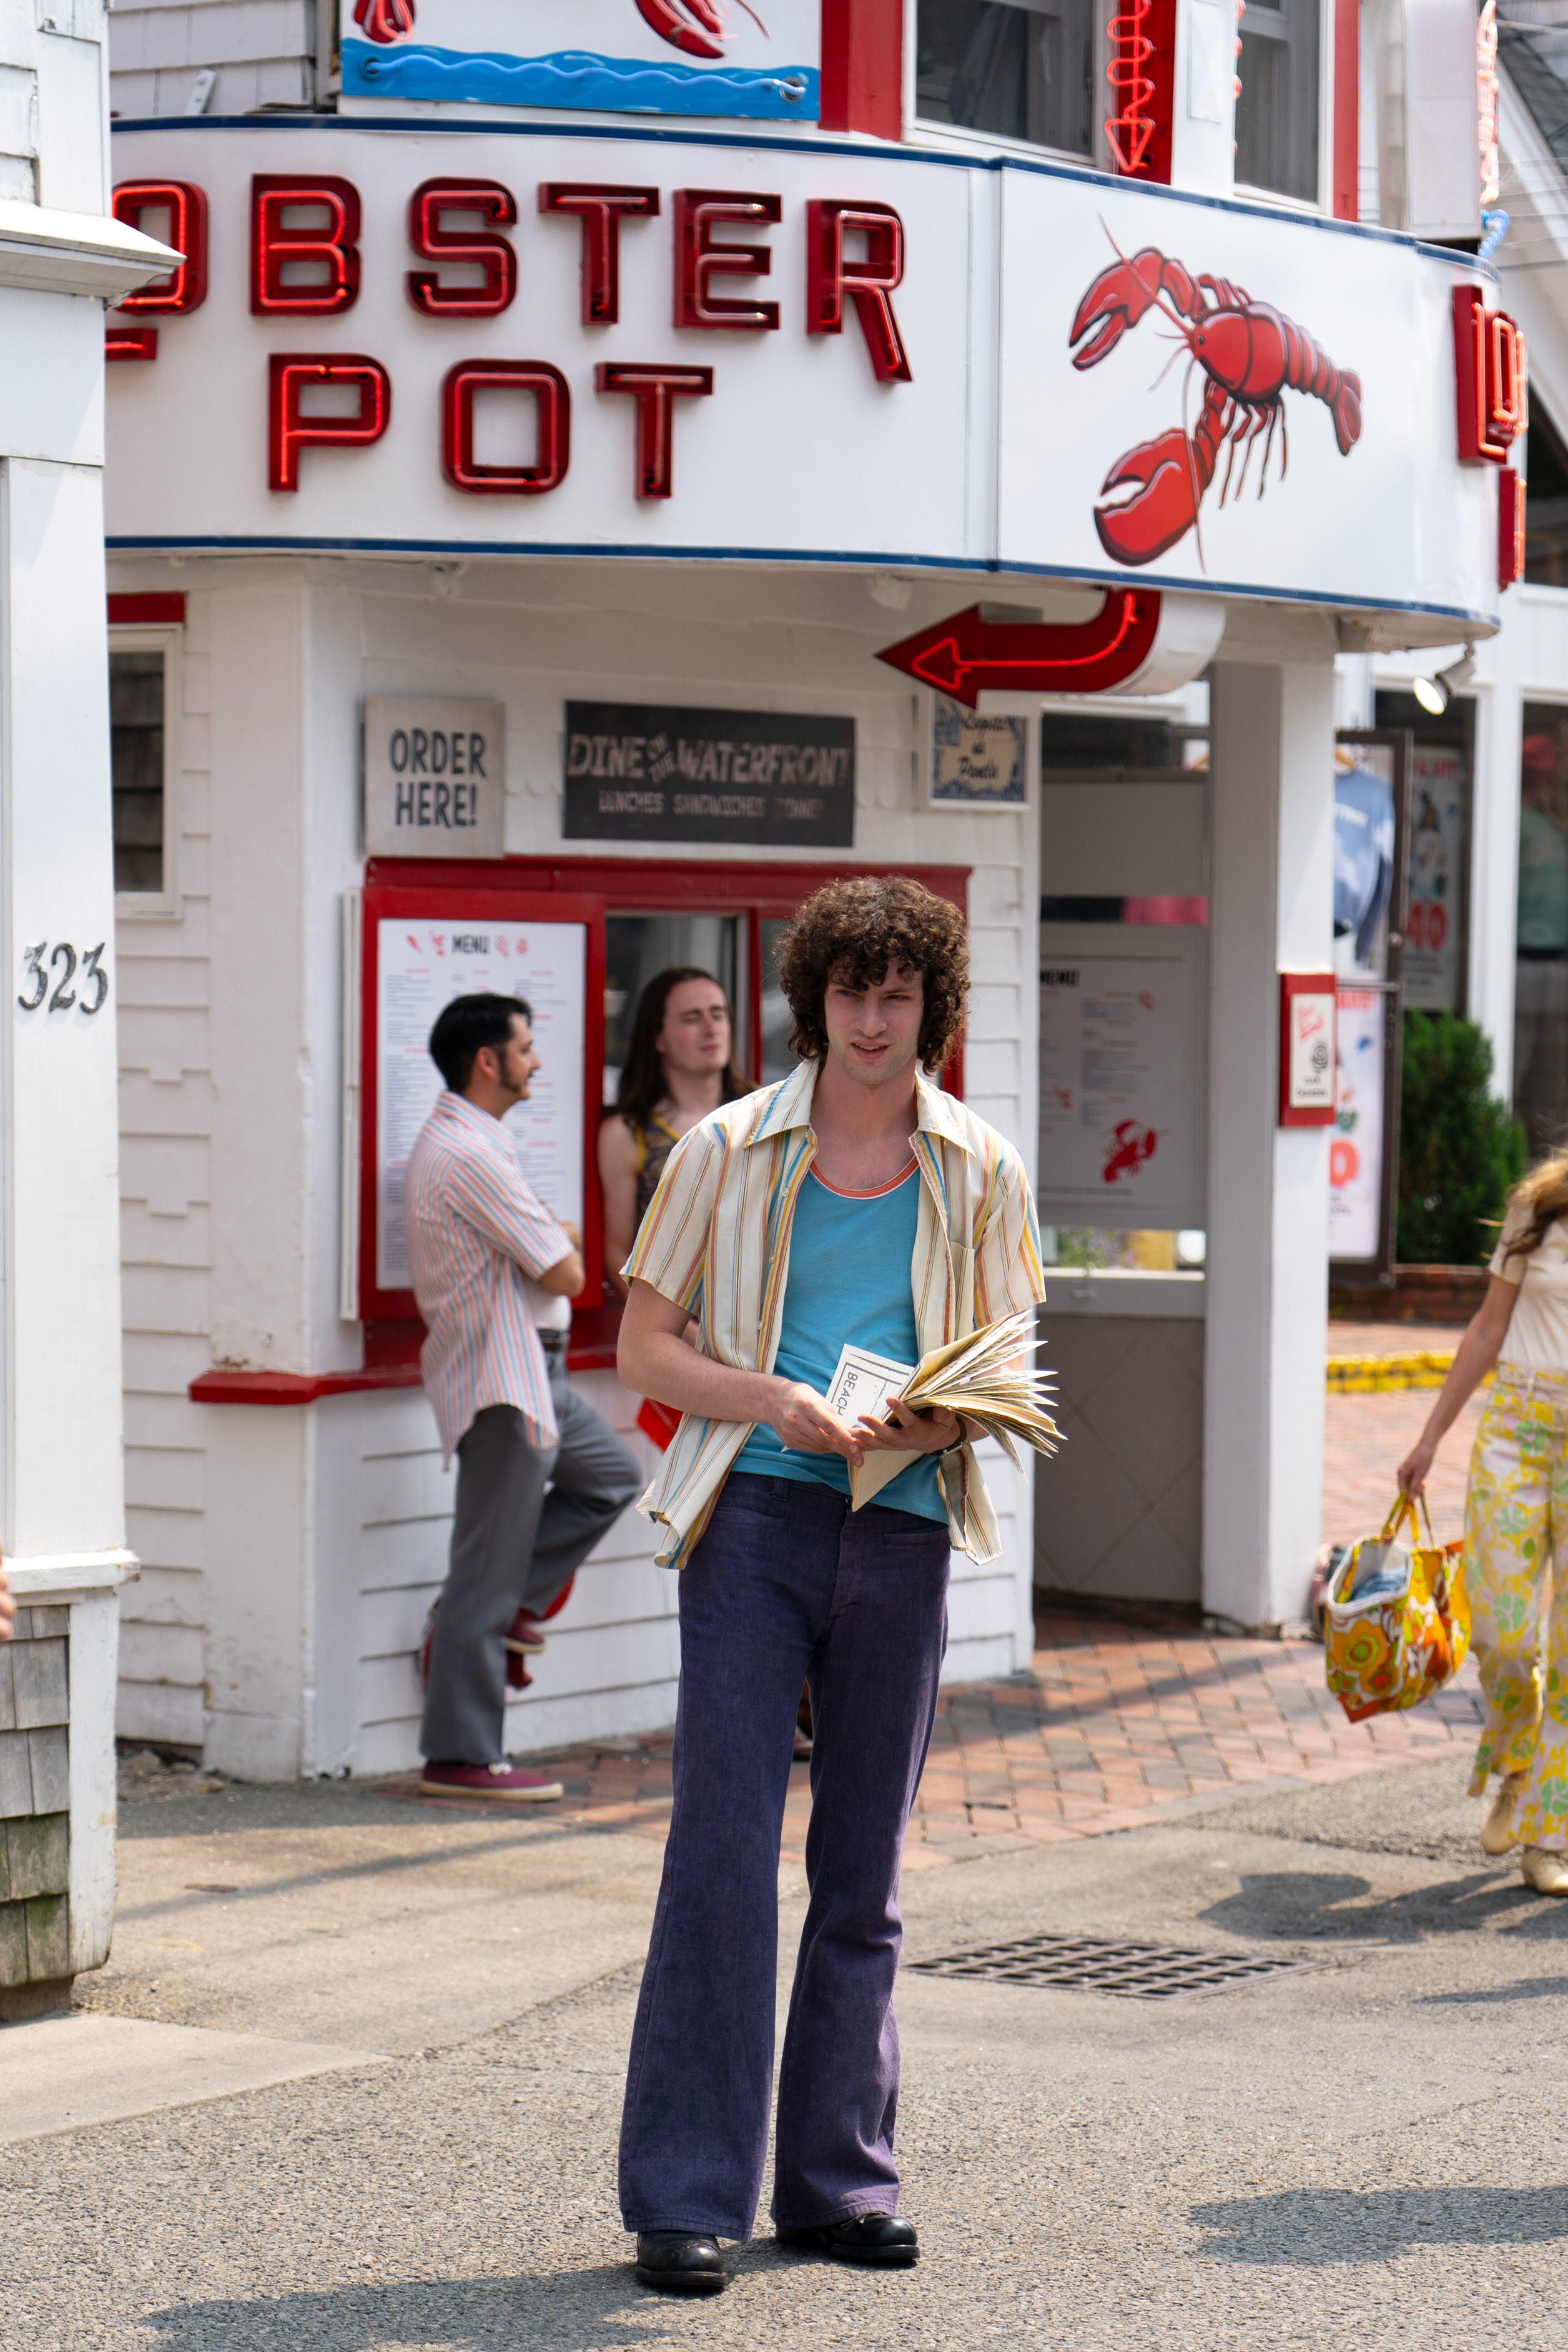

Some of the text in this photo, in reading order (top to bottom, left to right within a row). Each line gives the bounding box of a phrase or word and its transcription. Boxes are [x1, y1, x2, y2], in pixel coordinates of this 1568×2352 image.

[105, 173, 912, 382] OBSTER
[269, 352, 714, 501] POT
[390, 728, 487, 778] ORDER
[567, 733, 646, 779] DINE
[395, 782, 478, 829] HERE!
[672, 793, 766, 818] SANDWICHES
[451, 934, 490, 954] MENU
[17, 941, 109, 1015] 323
[836, 1372, 859, 1416] BEACH
